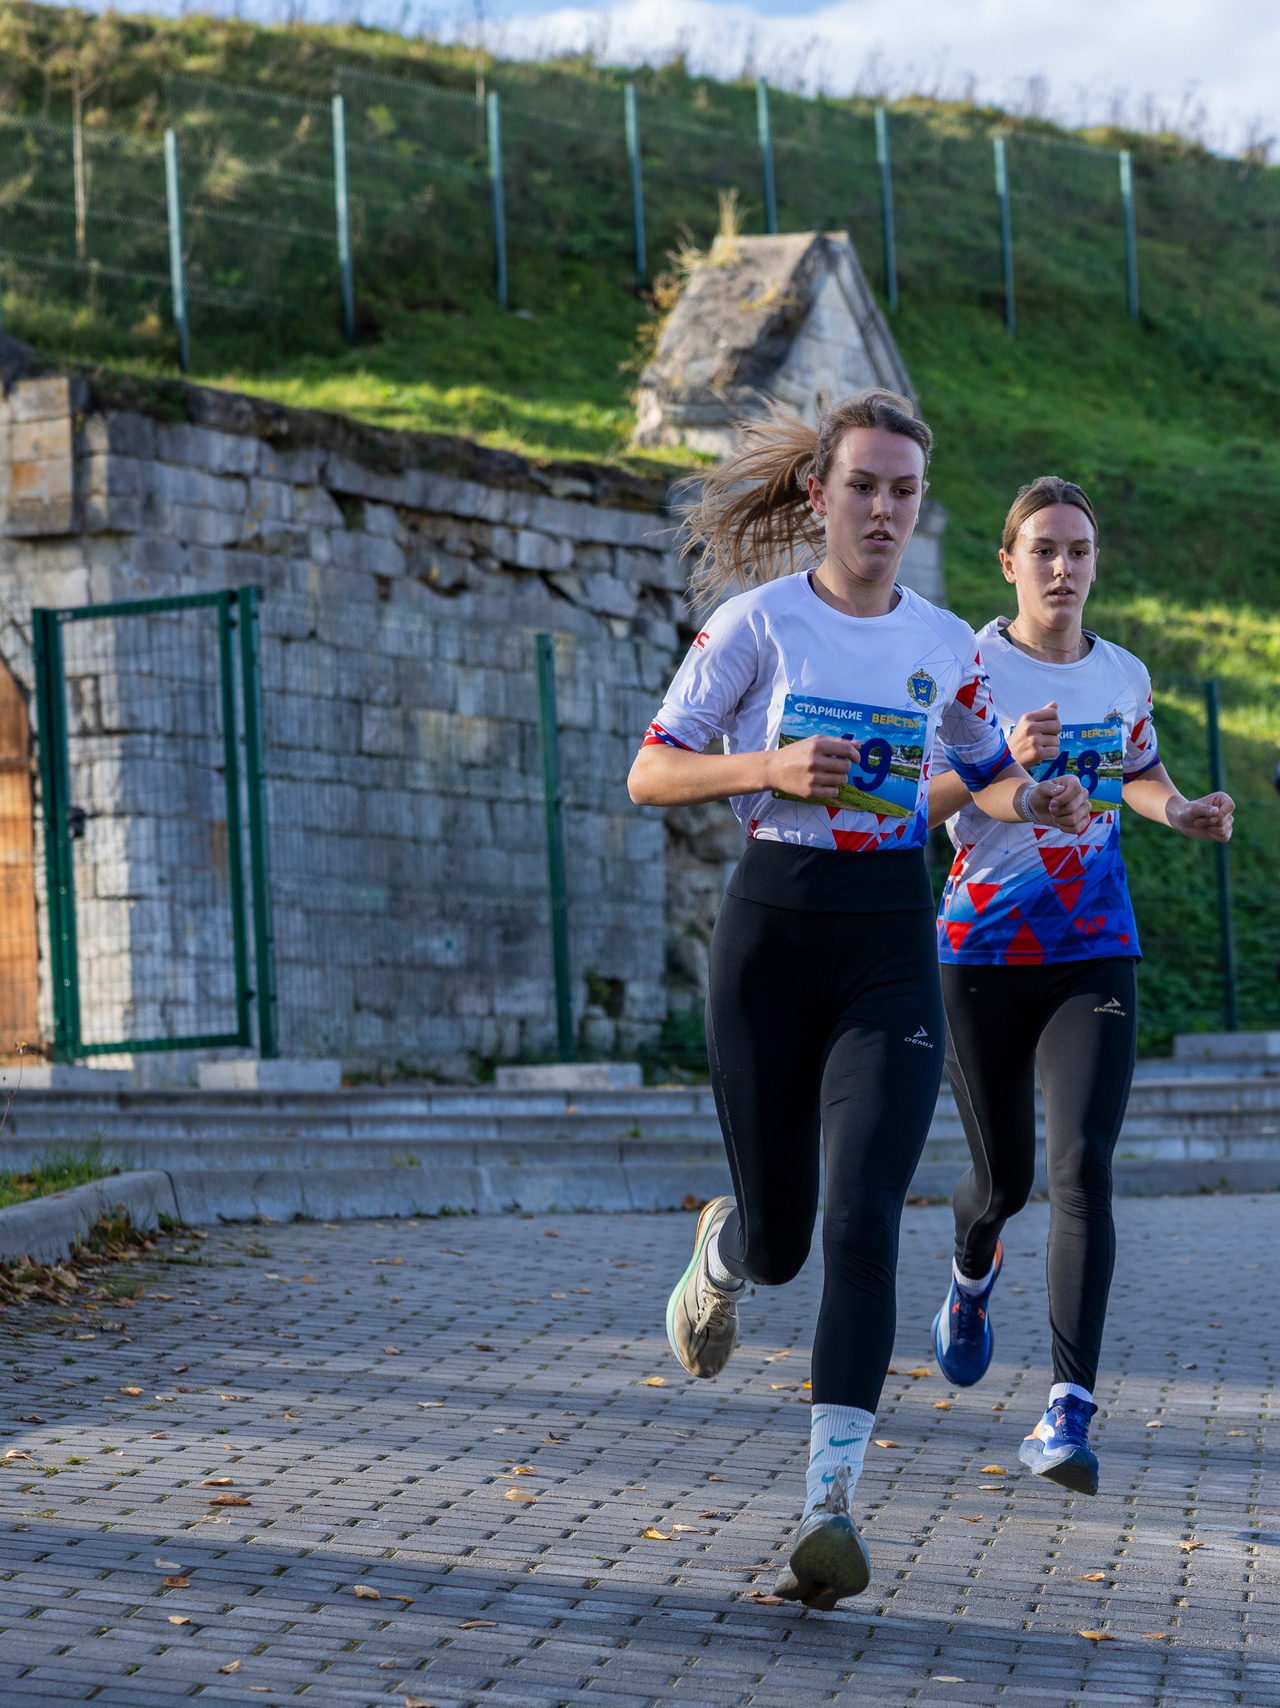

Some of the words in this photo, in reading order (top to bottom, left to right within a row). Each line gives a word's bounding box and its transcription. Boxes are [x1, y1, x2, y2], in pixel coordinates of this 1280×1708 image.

[794, 702, 863, 721] СТАРИЦКИЕ
[871, 713, 918, 730] ВЕРСТЫ
[1081, 728, 1116, 739] ВЕРСТЫ
[1093, 1007, 1127, 1017] DEMIX
[904, 1037, 934, 1049] DEMIX
